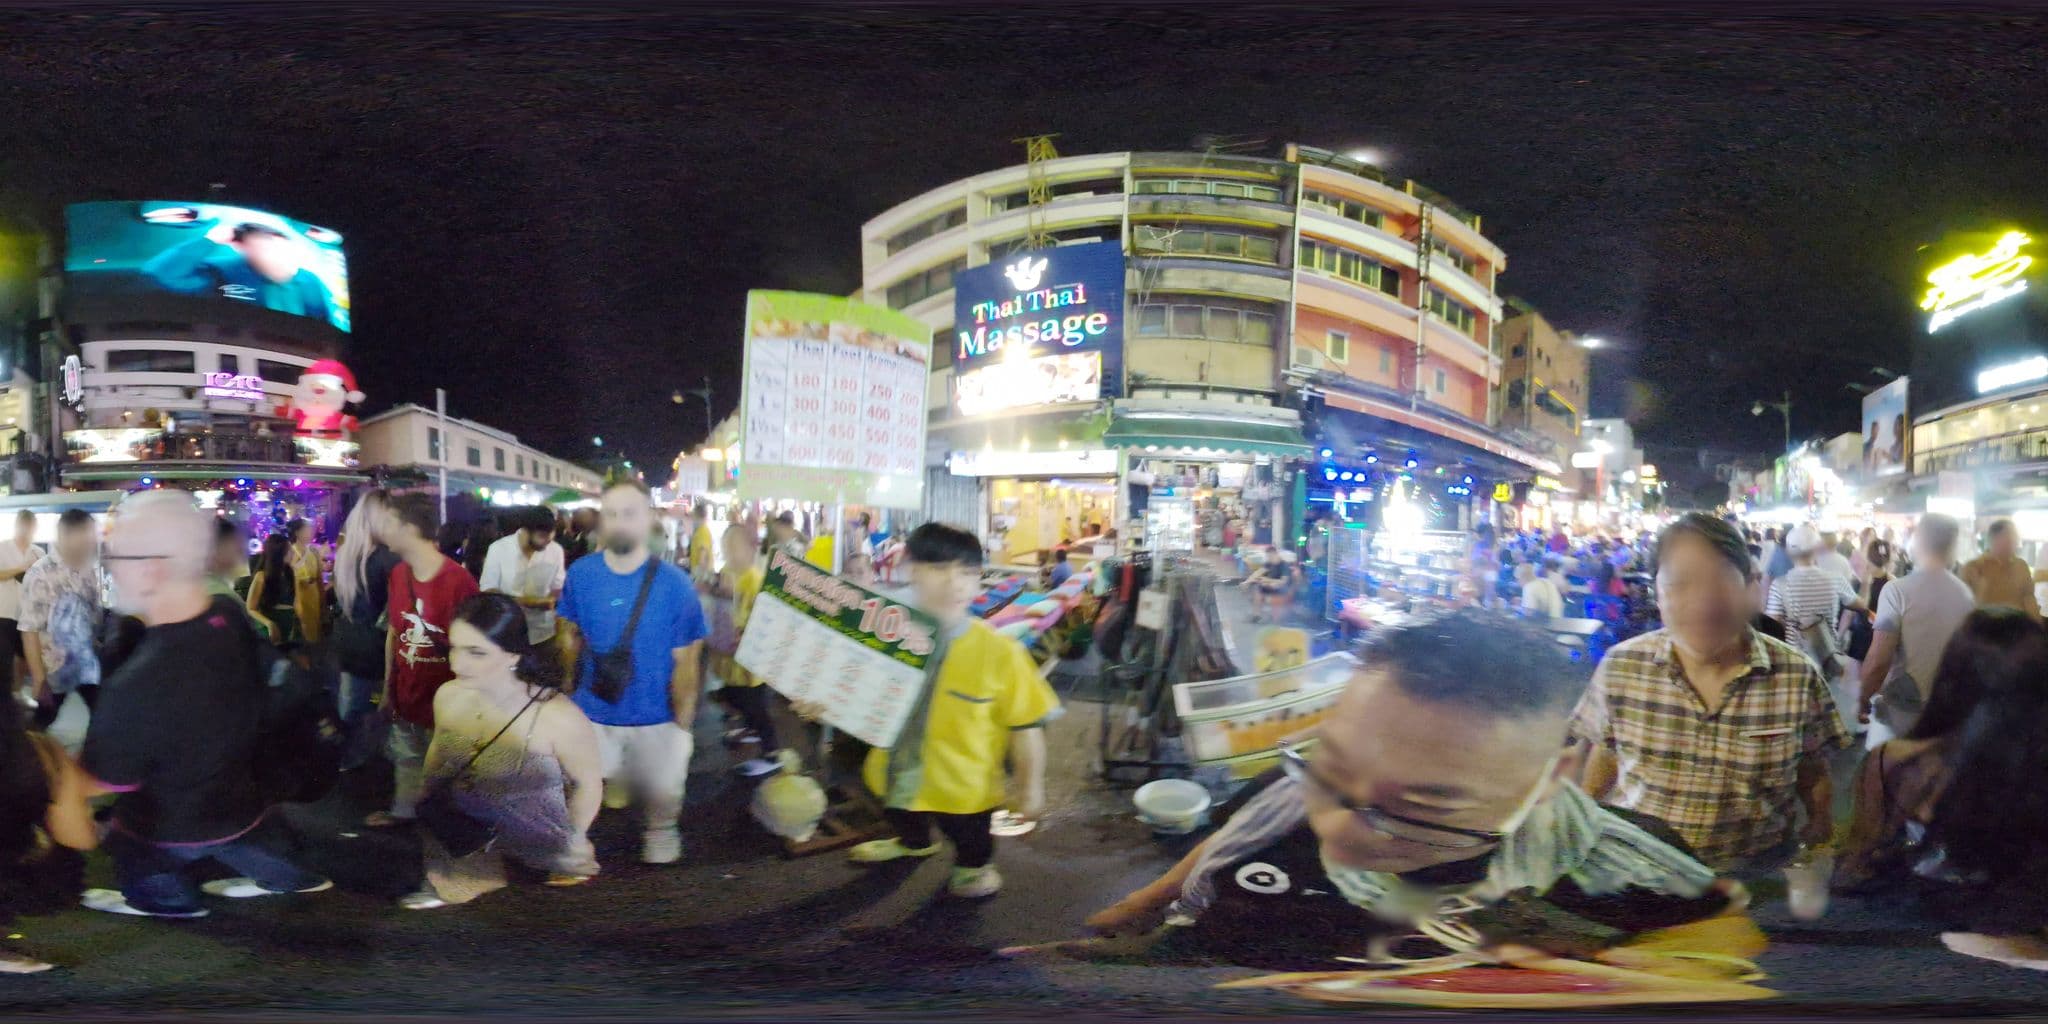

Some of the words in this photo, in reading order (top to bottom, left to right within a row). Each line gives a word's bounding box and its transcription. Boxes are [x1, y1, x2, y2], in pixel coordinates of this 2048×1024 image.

[973, 295, 1023, 324] Thai
[1026, 283, 1088, 311] Thai
[958, 312, 1108, 359] Massage
[794, 374, 820, 387] 180
[832, 377, 858, 392] 180
[867, 404, 891, 422] 400
[829, 423, 856, 441] 450
